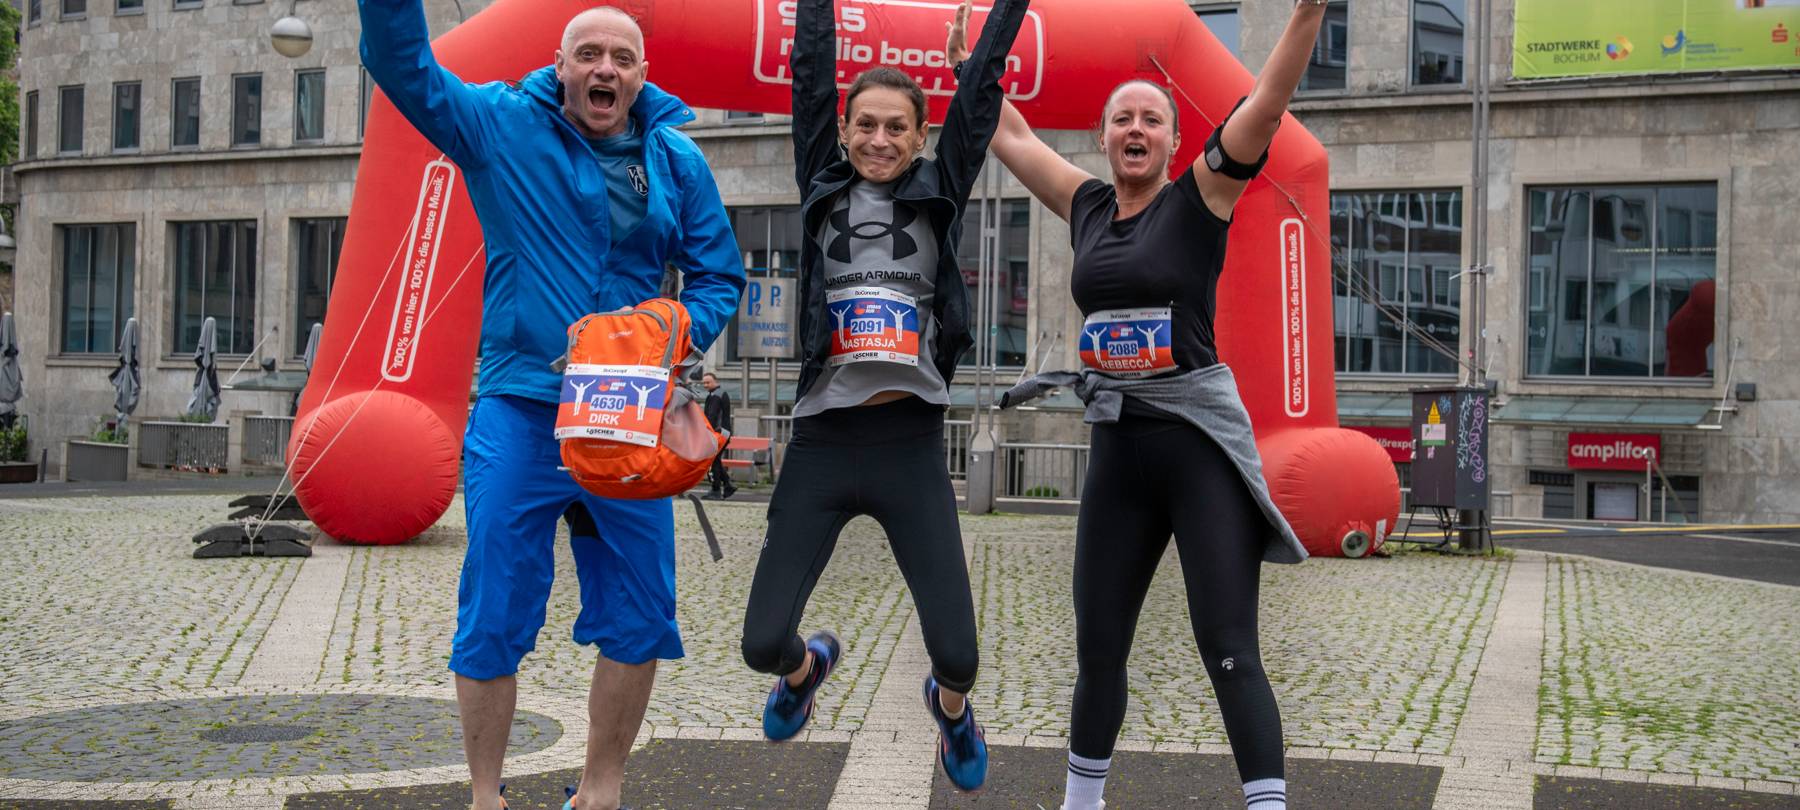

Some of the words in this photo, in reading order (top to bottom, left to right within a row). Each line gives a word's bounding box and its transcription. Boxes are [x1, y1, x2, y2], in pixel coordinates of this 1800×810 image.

[778, 0, 866, 32] 9.5
[780, 37, 873, 63] rio
[1527, 40, 1600, 53] STADTWERKE
[1553, 52, 1600, 64] BOCHUM
[428, 174, 444, 209] Musik.
[421, 210, 437, 240] beste
[418, 241, 430, 257] die
[1288, 229, 1298, 262] Musik.
[410, 258, 426, 289] 100%
[825, 272, 863, 286] UNDER
[865, 270, 921, 281] ARMOUR
[1290, 262, 1299, 290] beste
[1290, 290, 1300, 306] die
[403, 316, 413, 334] von
[851, 320, 882, 334] 2091
[1291, 306, 1300, 336] 100%
[393, 337, 408, 368] 100%
[842, 337, 896, 350] NASTASJA
[1109, 343, 1138, 356] 2088
[1292, 336, 1301, 357] hier.
[1100, 358, 1153, 370] REBECCA
[1293, 376, 1302, 406] 100%
[591, 396, 625, 411] 4630
[588, 413, 621, 425] DIRK
